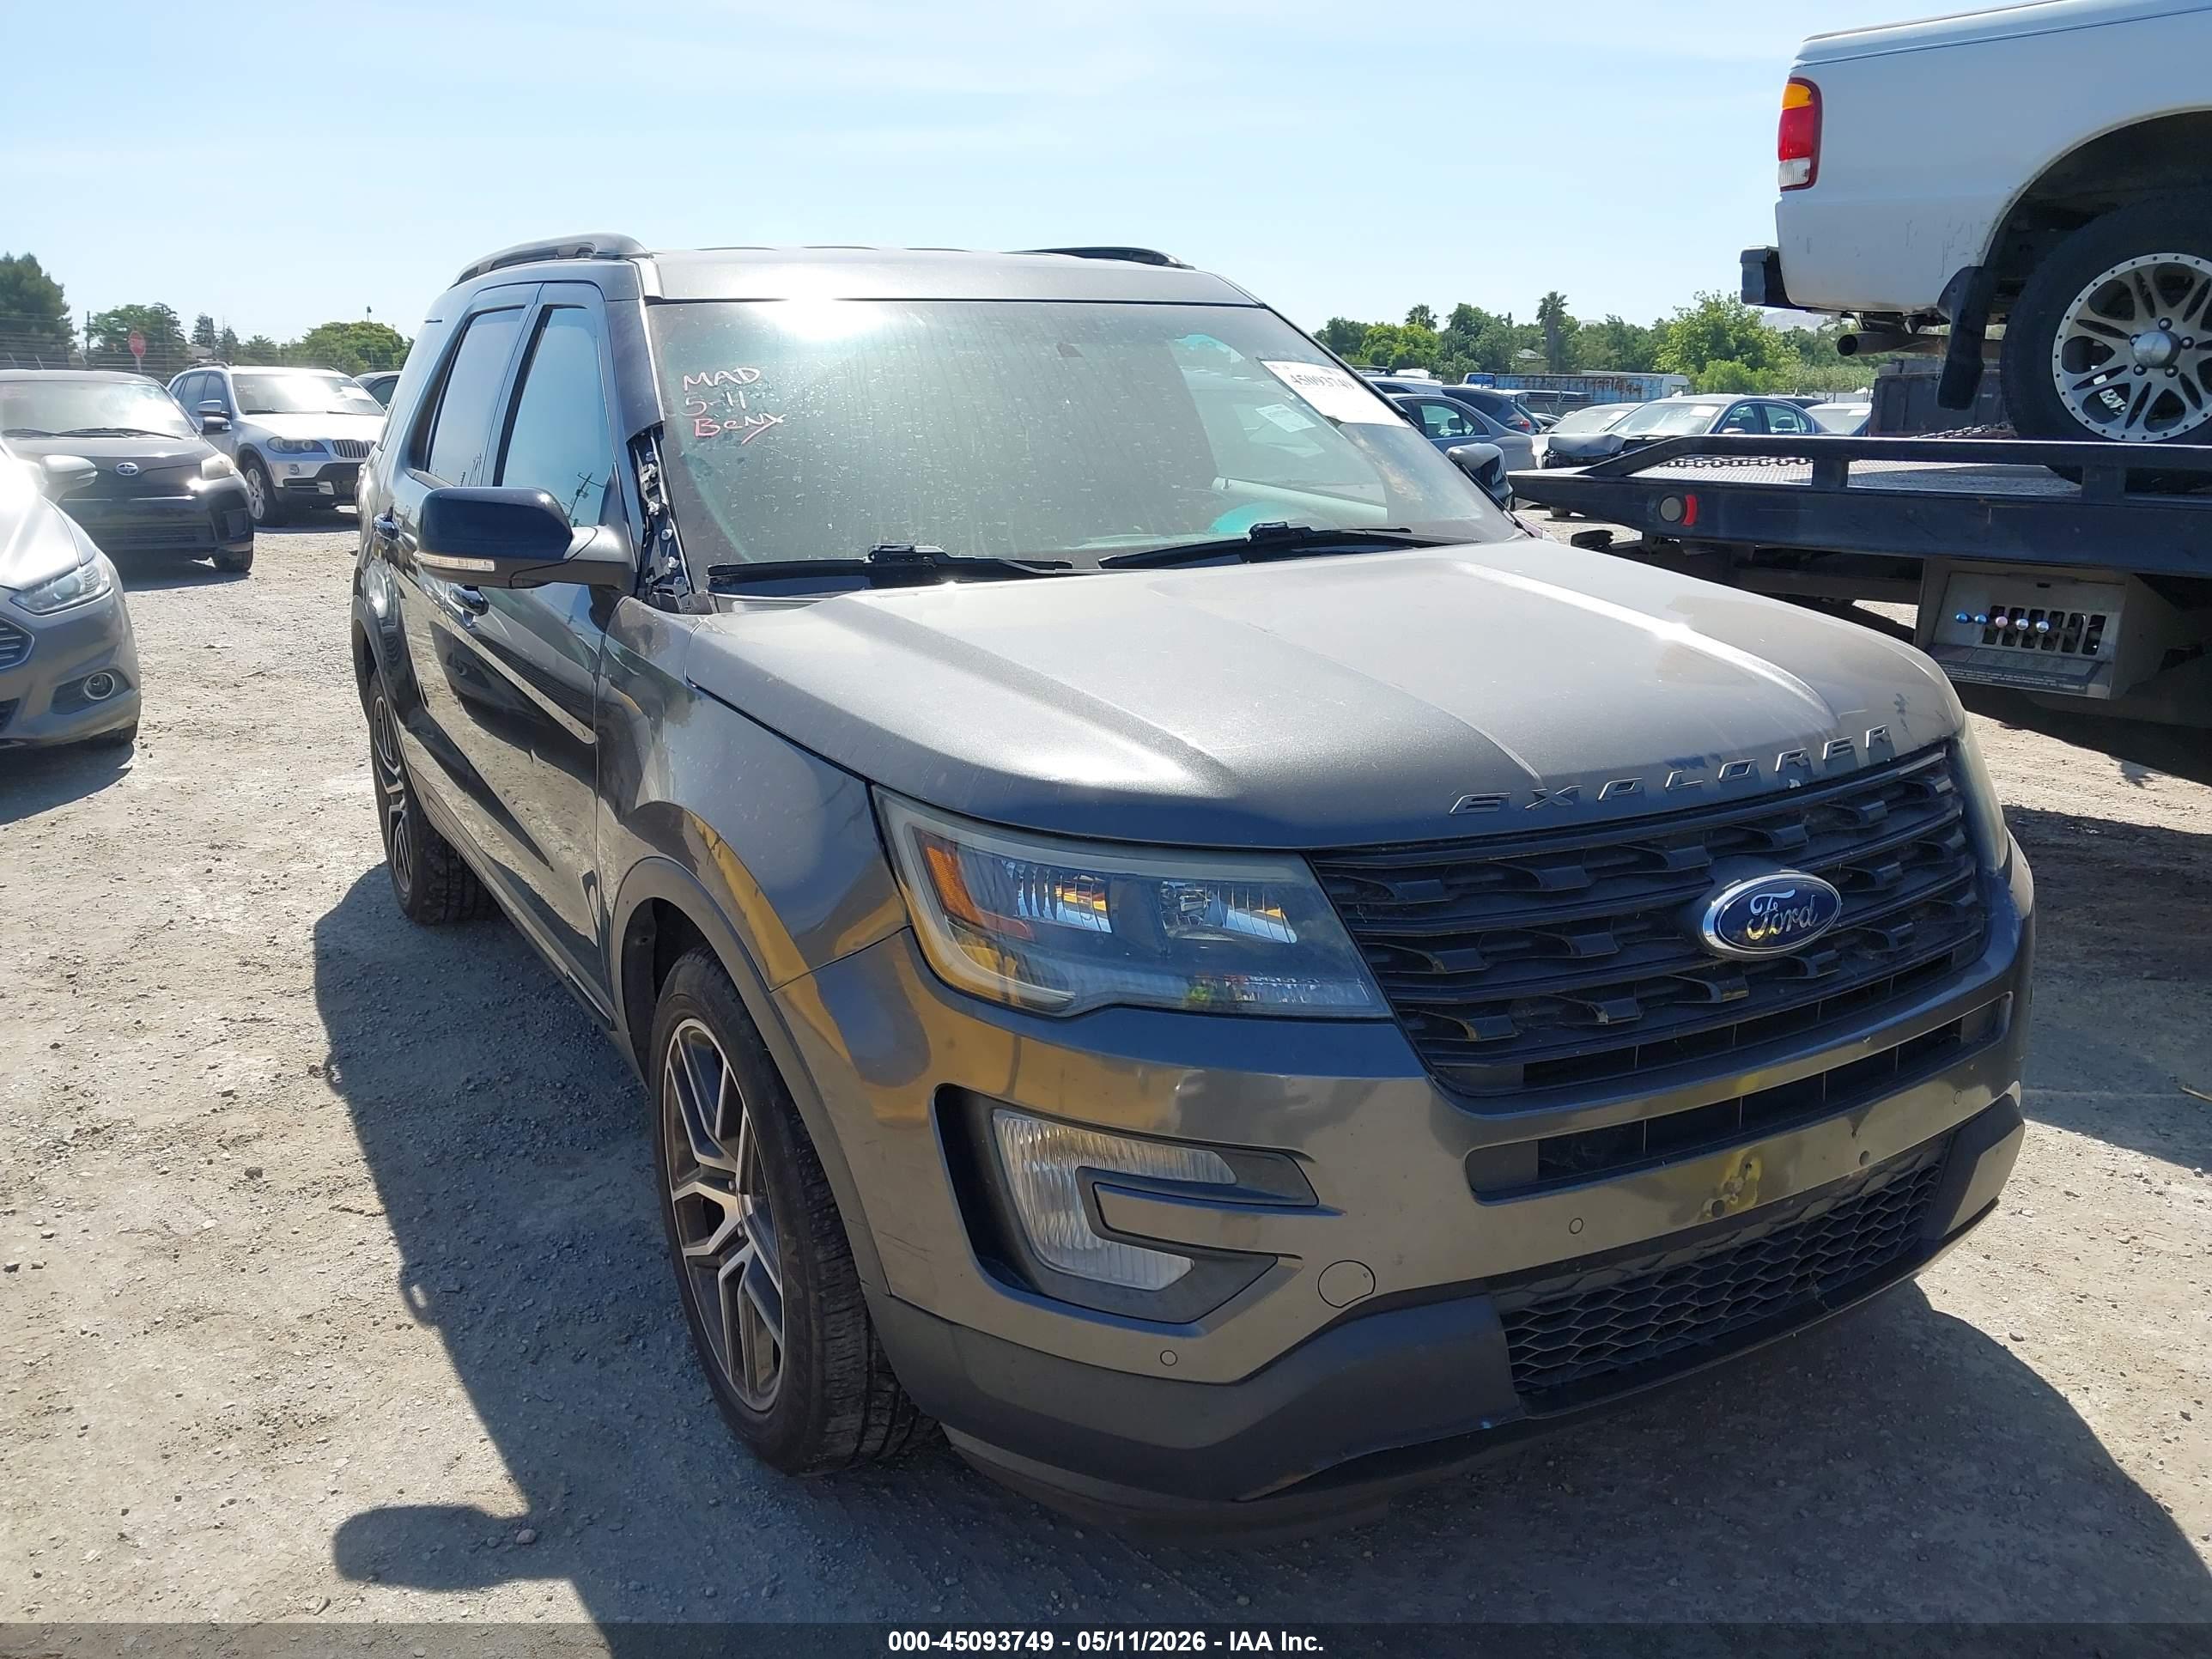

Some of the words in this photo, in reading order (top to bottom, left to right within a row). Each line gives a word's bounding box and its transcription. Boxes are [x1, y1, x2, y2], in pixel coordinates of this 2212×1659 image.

[684, 367, 762, 391] MAD
[681, 391, 746, 416] 5-11
[1449, 724, 1891, 815] EXPLORER
[1746, 888, 1819, 941] Ford
